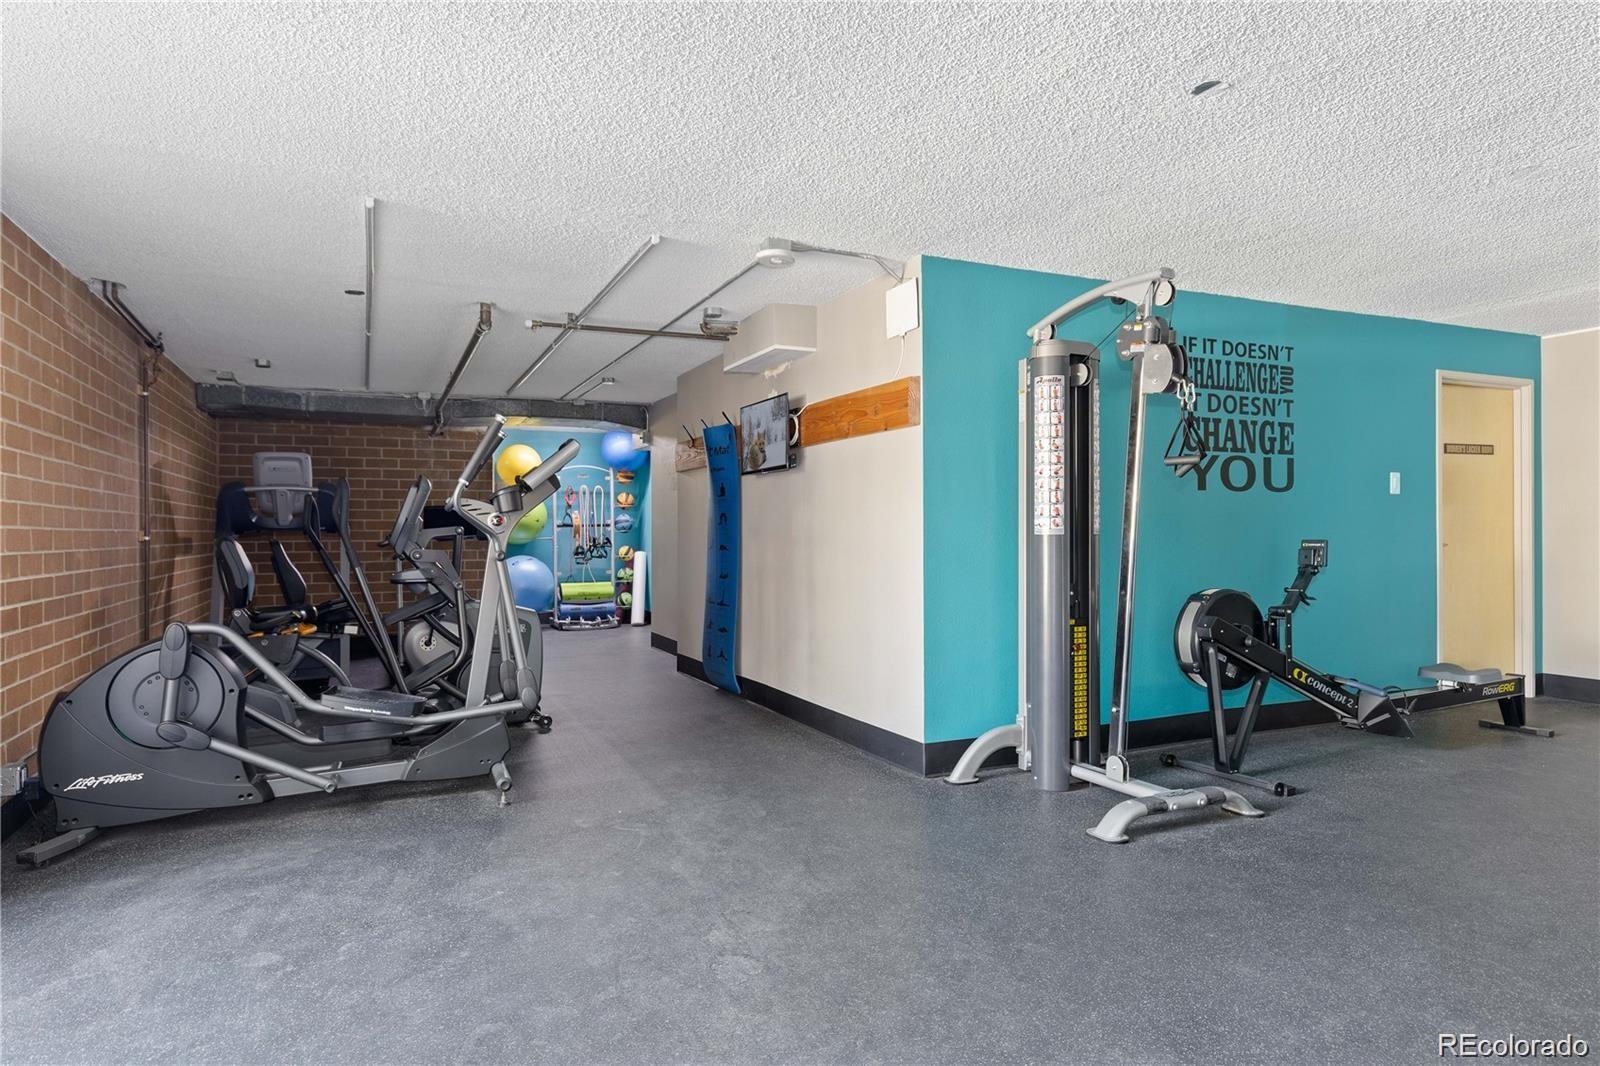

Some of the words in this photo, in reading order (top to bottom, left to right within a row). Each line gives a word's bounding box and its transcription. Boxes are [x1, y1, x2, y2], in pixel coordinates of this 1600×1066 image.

[1183, 336, 1198, 353] IF
[1203, 338, 1217, 354] IT
[1222, 340, 1294, 362] DOESN'T
[1280, 365, 1294, 394] YOU
[1208, 393, 1294, 418] DOESN'T
[1184, 454, 1294, 492] YOU
